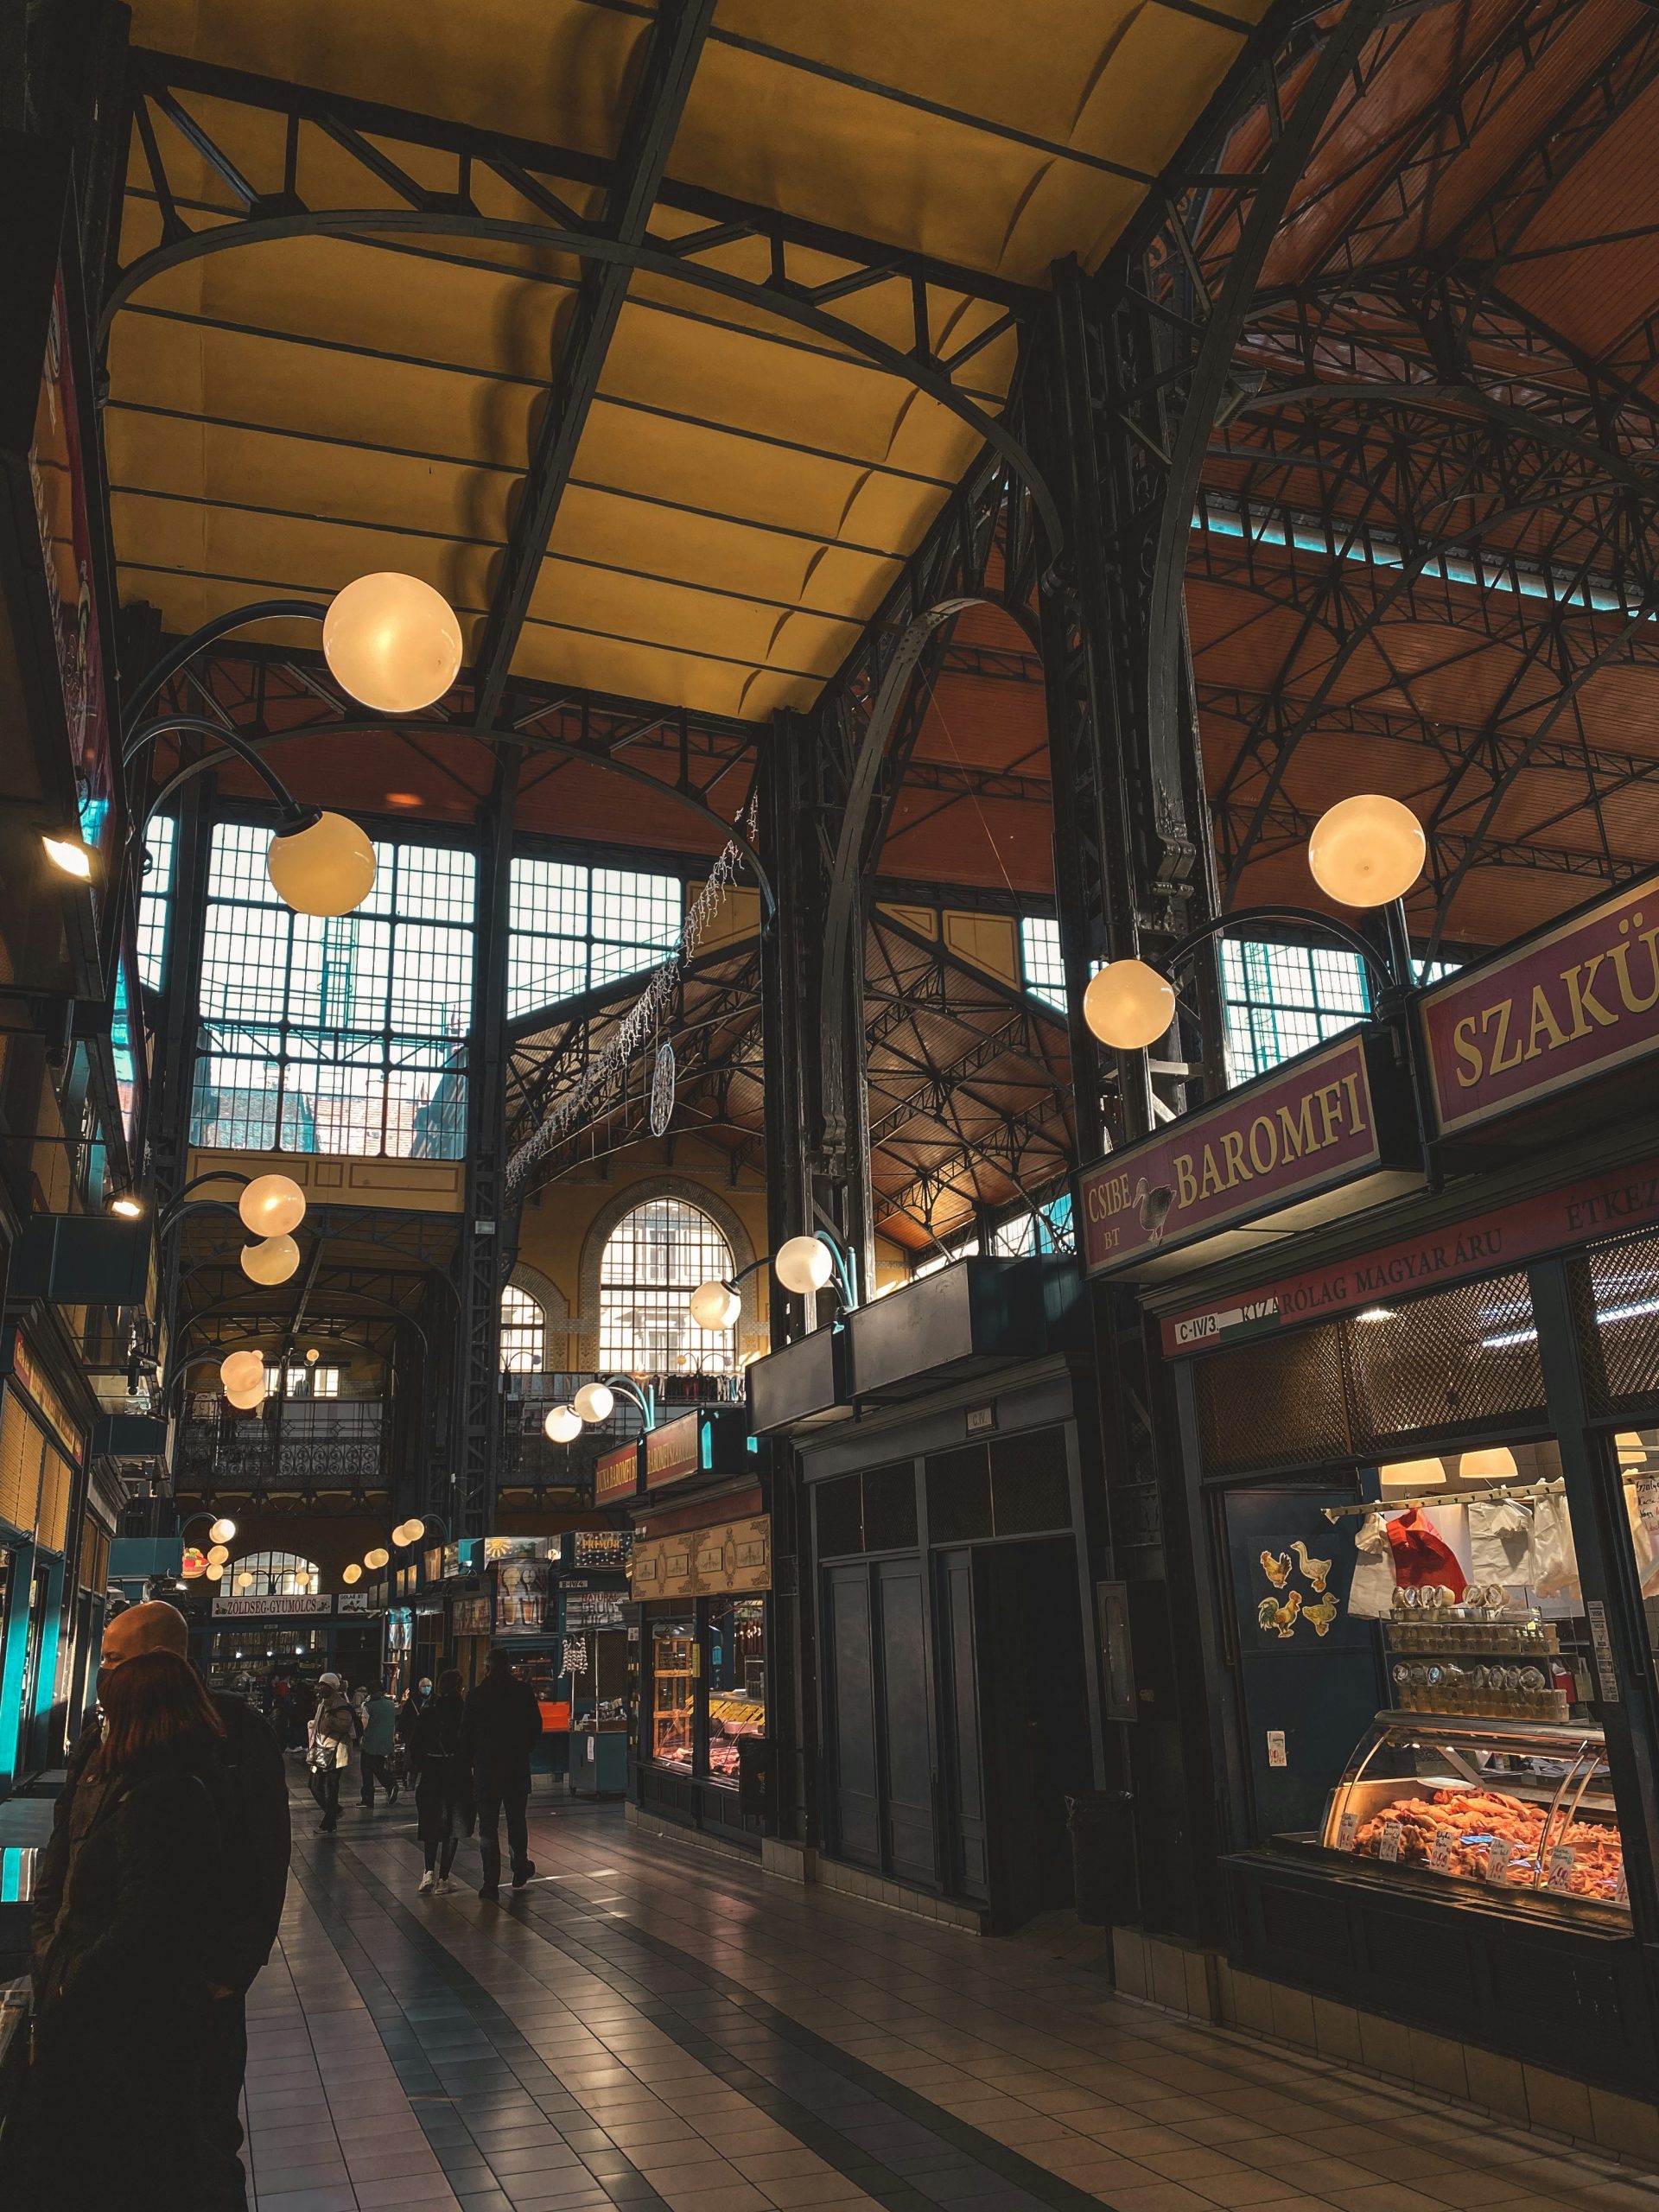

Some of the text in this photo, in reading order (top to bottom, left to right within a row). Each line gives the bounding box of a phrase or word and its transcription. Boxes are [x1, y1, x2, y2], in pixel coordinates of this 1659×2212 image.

[1453, 912, 1659, 1088] SZAKÜ
[1173, 1072, 1366, 1210] BAROMFI
[1088, 1173, 1132, 1223] CSIBE
[1104, 1228, 1121, 1250] BT
[1354, 1247, 1452, 1294] MAGYAR
[1453, 1227, 1503, 1267] ÁRU
[1179, 1315, 1220, 1341] C-IV/3.
[582, 1601, 615, 1614] FRUIT
